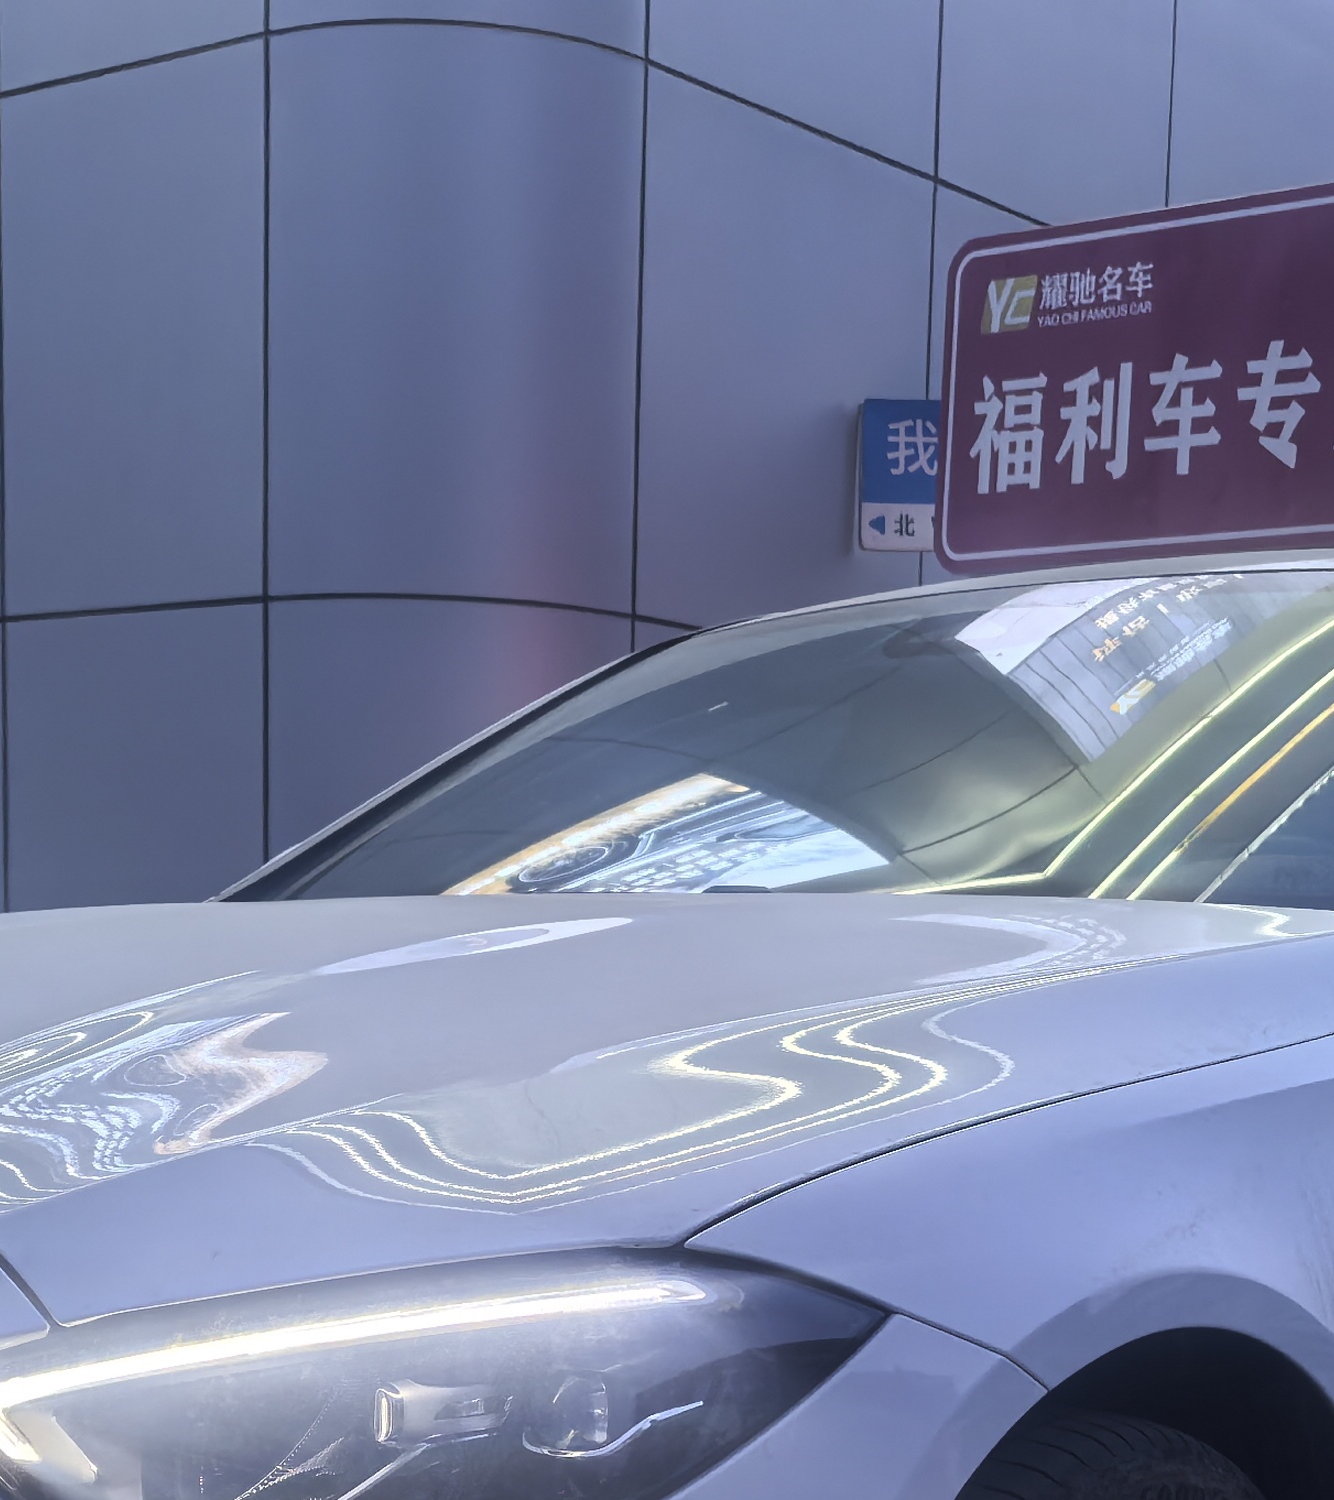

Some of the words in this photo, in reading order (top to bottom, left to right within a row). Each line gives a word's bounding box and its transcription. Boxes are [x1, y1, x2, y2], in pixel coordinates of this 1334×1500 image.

[1039, 261, 1154, 310] 耀驰名车
[1037, 314, 1059, 327] YAO
[1061, 311, 1078, 325] CHI
[1080, 303, 1128, 322] FAMOUS
[1129, 301, 1152, 316] CAR
[887, 418, 938, 476] 我
[893, 513, 915, 537] 北
